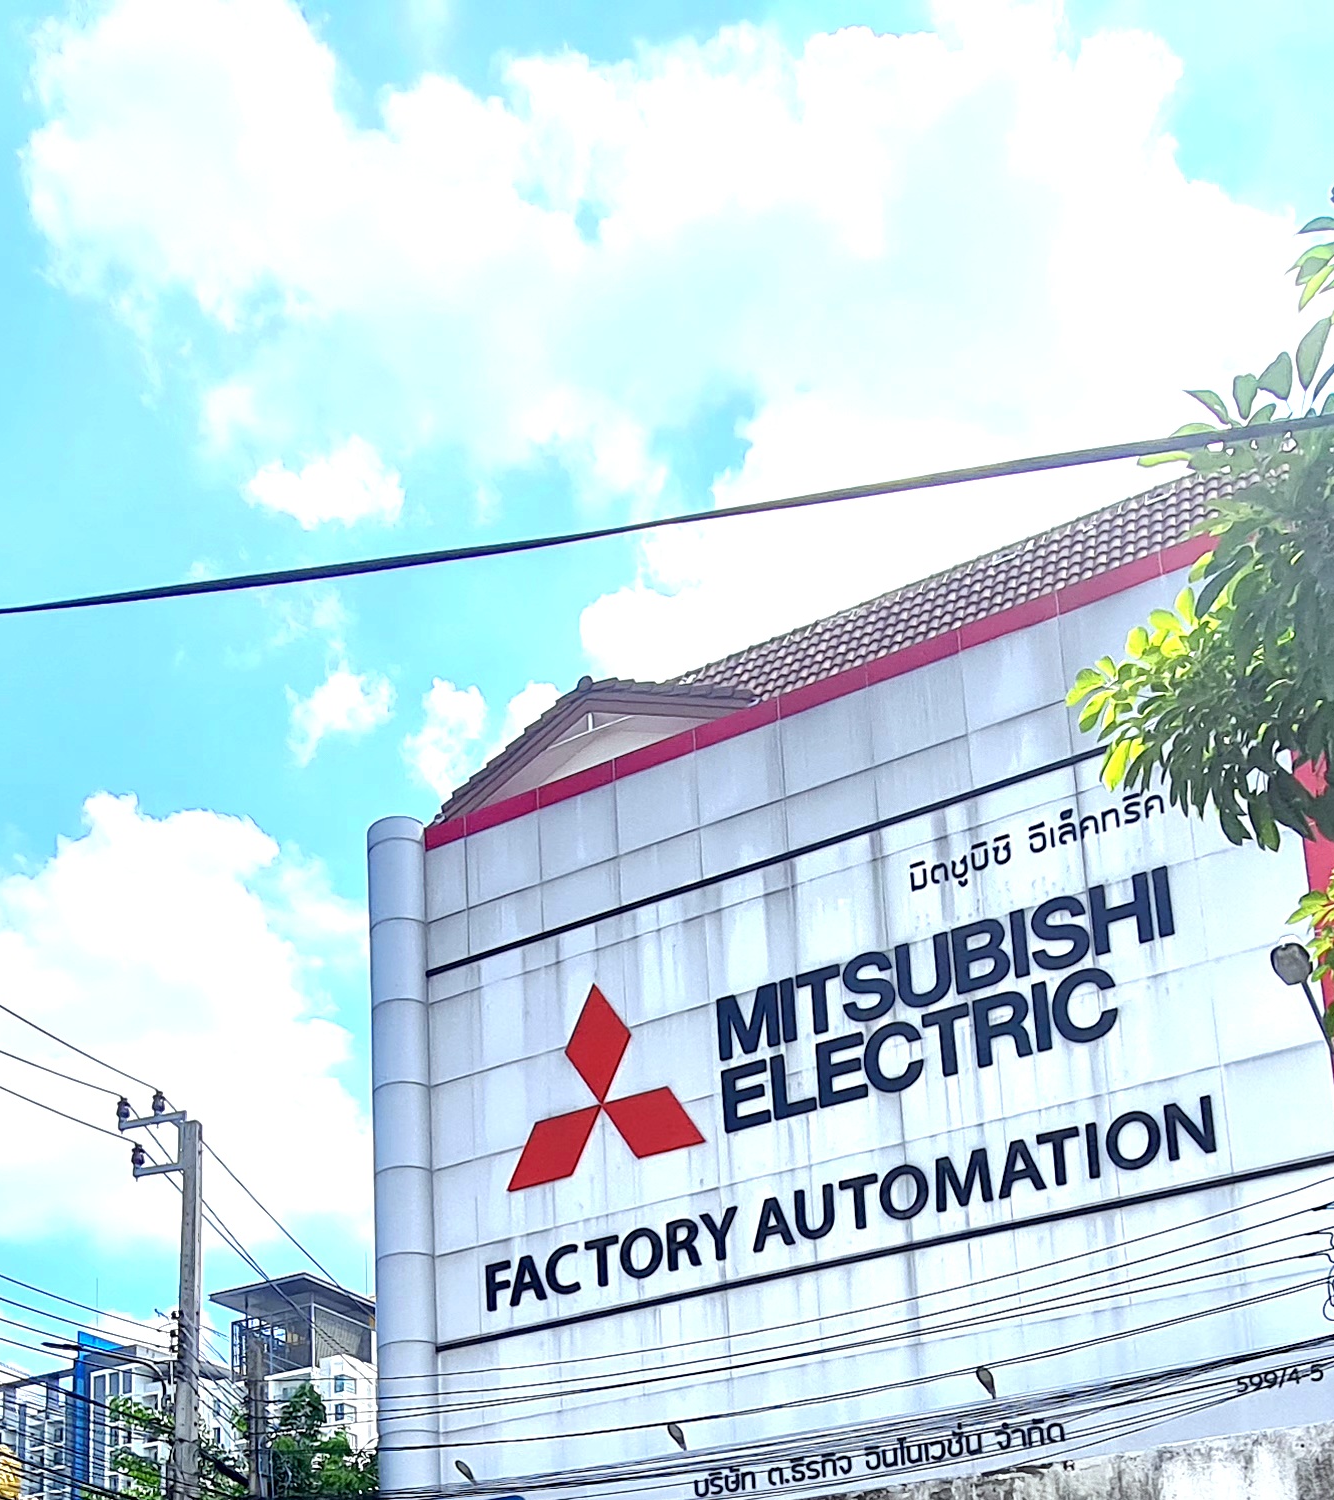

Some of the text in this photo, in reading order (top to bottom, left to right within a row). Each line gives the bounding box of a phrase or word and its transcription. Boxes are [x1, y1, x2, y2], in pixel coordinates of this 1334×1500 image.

[717, 867, 1175, 1061] MITSUBISHI
[722, 967, 1118, 1133] ELECTRIC
[484, 1094, 1218, 1313] FACTORY AUTOMATION
[1236, 1363, 1324, 1394] 599/4-5
